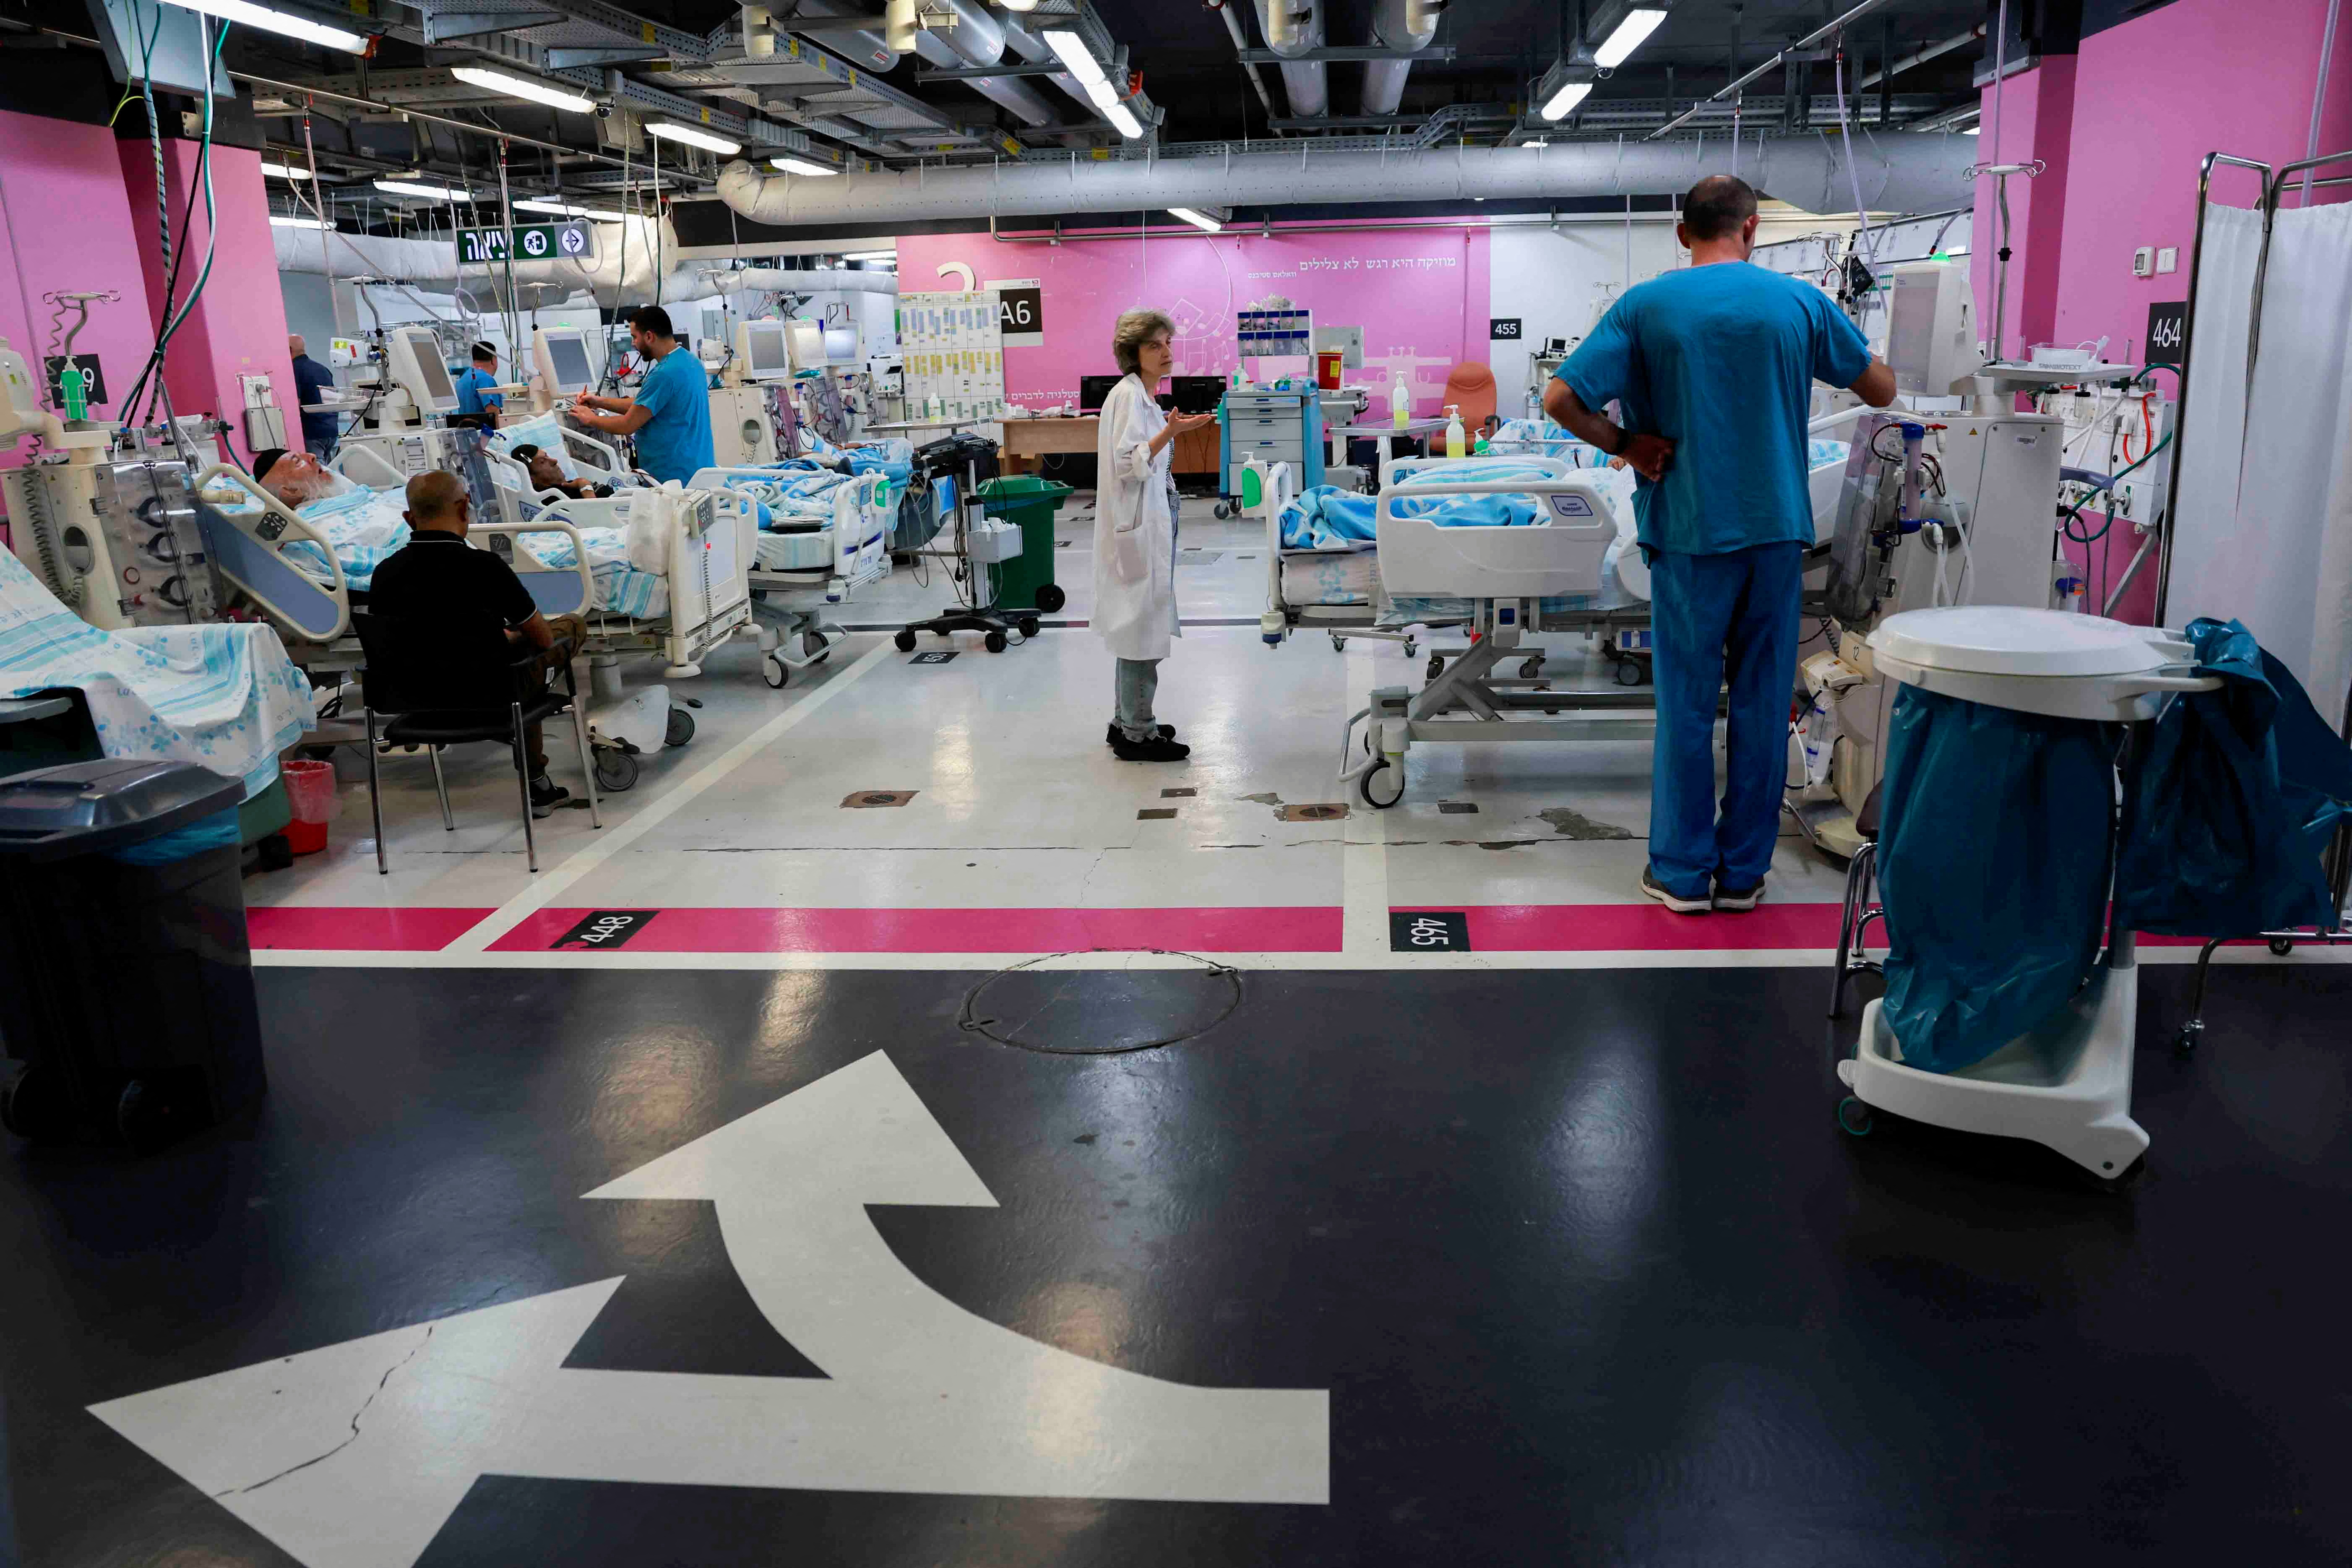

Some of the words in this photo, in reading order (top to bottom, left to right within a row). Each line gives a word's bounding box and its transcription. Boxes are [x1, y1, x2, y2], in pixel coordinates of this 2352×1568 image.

[1300, 257, 1339, 271] צלילים
[1344, 256, 1359, 269] לא
[1366, 259, 1388, 269] רגש
[1391, 258, 1413, 268] היא
[1417, 257, 1457, 271] מוזיקה
[1001, 300, 1031, 325] A6
[1495, 323, 1517, 335] 455
[2152, 318, 2181, 347] 464
[1011, 389, 1044, 400] לדברים
[1853, 646, 1860, 662] 12
[580, 916, 634, 943] 448
[1410, 918, 1449, 945] 465
